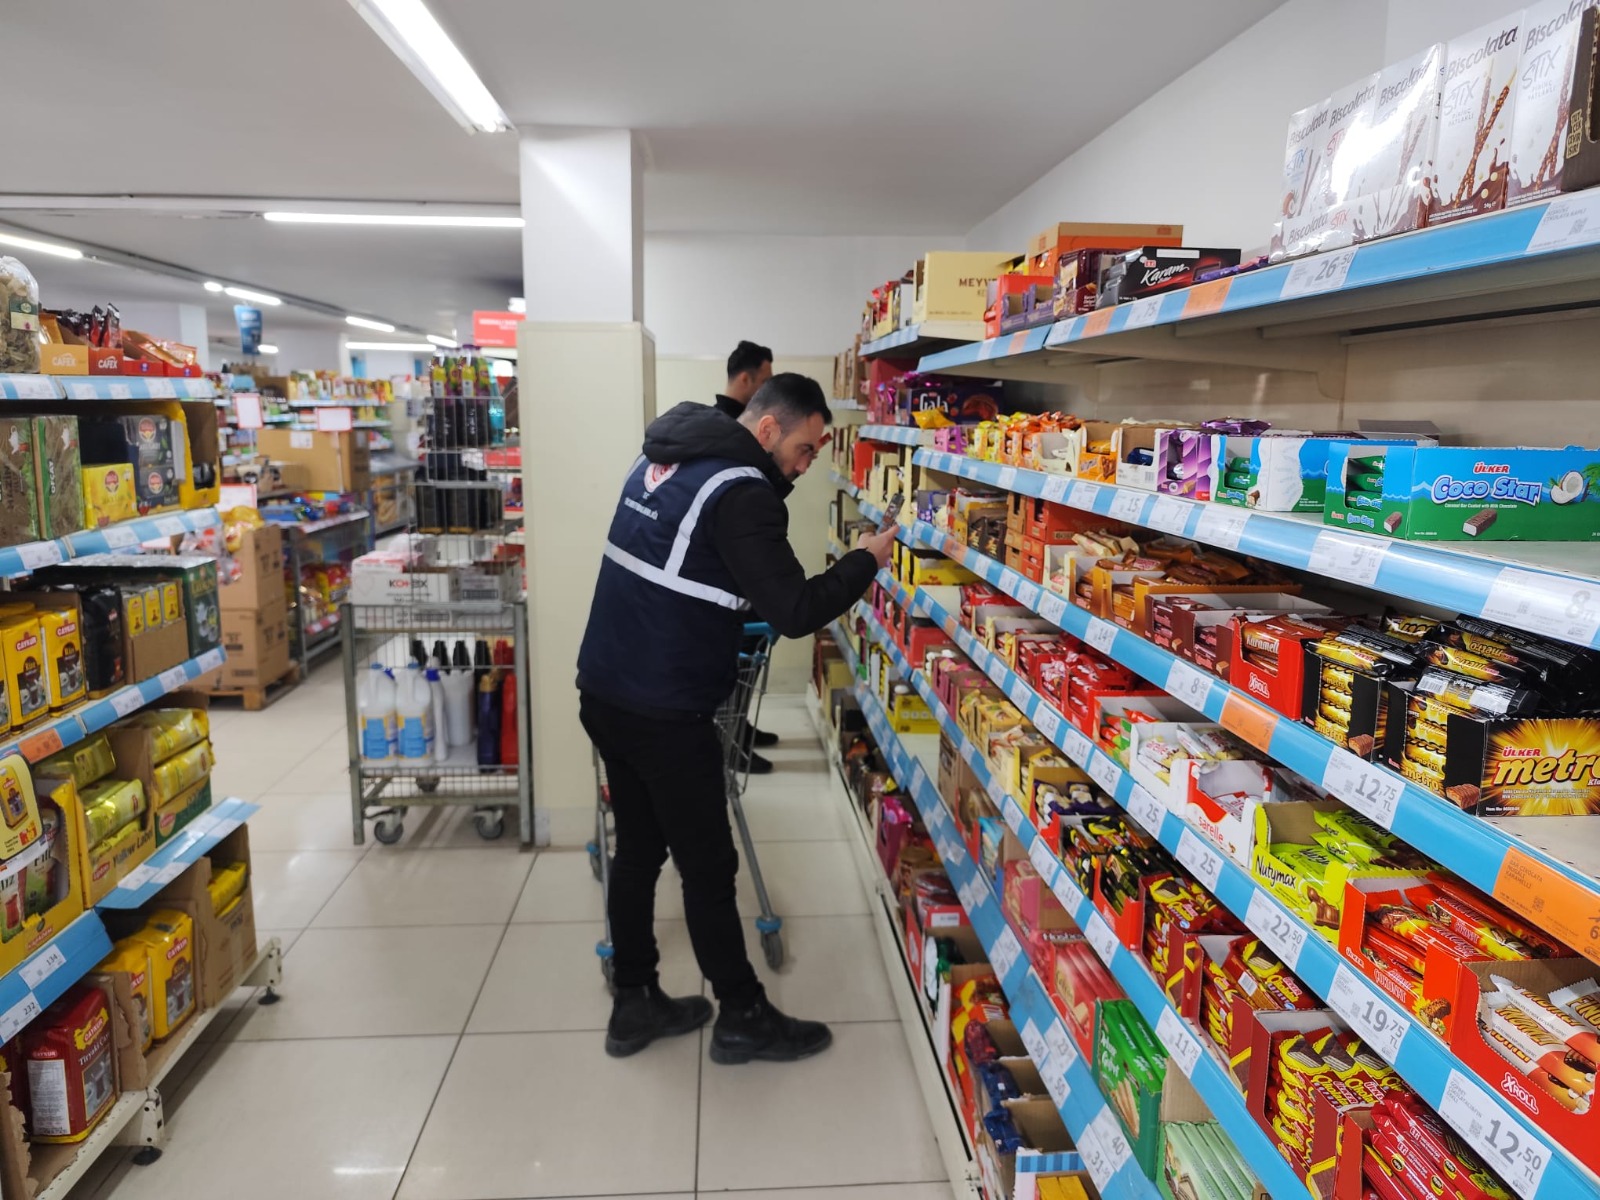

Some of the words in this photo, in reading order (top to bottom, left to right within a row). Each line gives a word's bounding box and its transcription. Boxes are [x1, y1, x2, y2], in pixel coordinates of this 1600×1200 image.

[1444, 26, 1519, 84] Biscolata
[1140, 263, 1190, 286] Karam
[1473, 462, 1510, 474] ÜLKER
[1431, 475, 1490, 504] Coco
[1492, 476, 1543, 506] Star
[1502, 746, 1541, 757] ÜLKER
[1355, 772, 1398, 803] 12,75
[1404, 765, 1440, 791] metro
[1145, 804, 1158, 824] 25
[1198, 815, 1224, 843] sarelle
[1200, 852, 1216, 876] 25
[1256, 855, 1297, 889] Nutymax
[1270, 914, 1303, 944] 22,50
[46, 953, 58, 966] 134
[23, 1001, 37, 1016] 232
[1361, 1000, 1405, 1038] 19,75
[1390, 1036, 1398, 1049] TL
[1332, 1080, 1359, 1104] ÜLKER
[1363, 1081, 1385, 1105] ÜLKE
[1501, 1072, 1539, 1115] XROLL
[1111, 1137, 1126, 1155] 40
[1484, 1119, 1542, 1171] 12,50
[1523, 1165, 1535, 1184] TL
